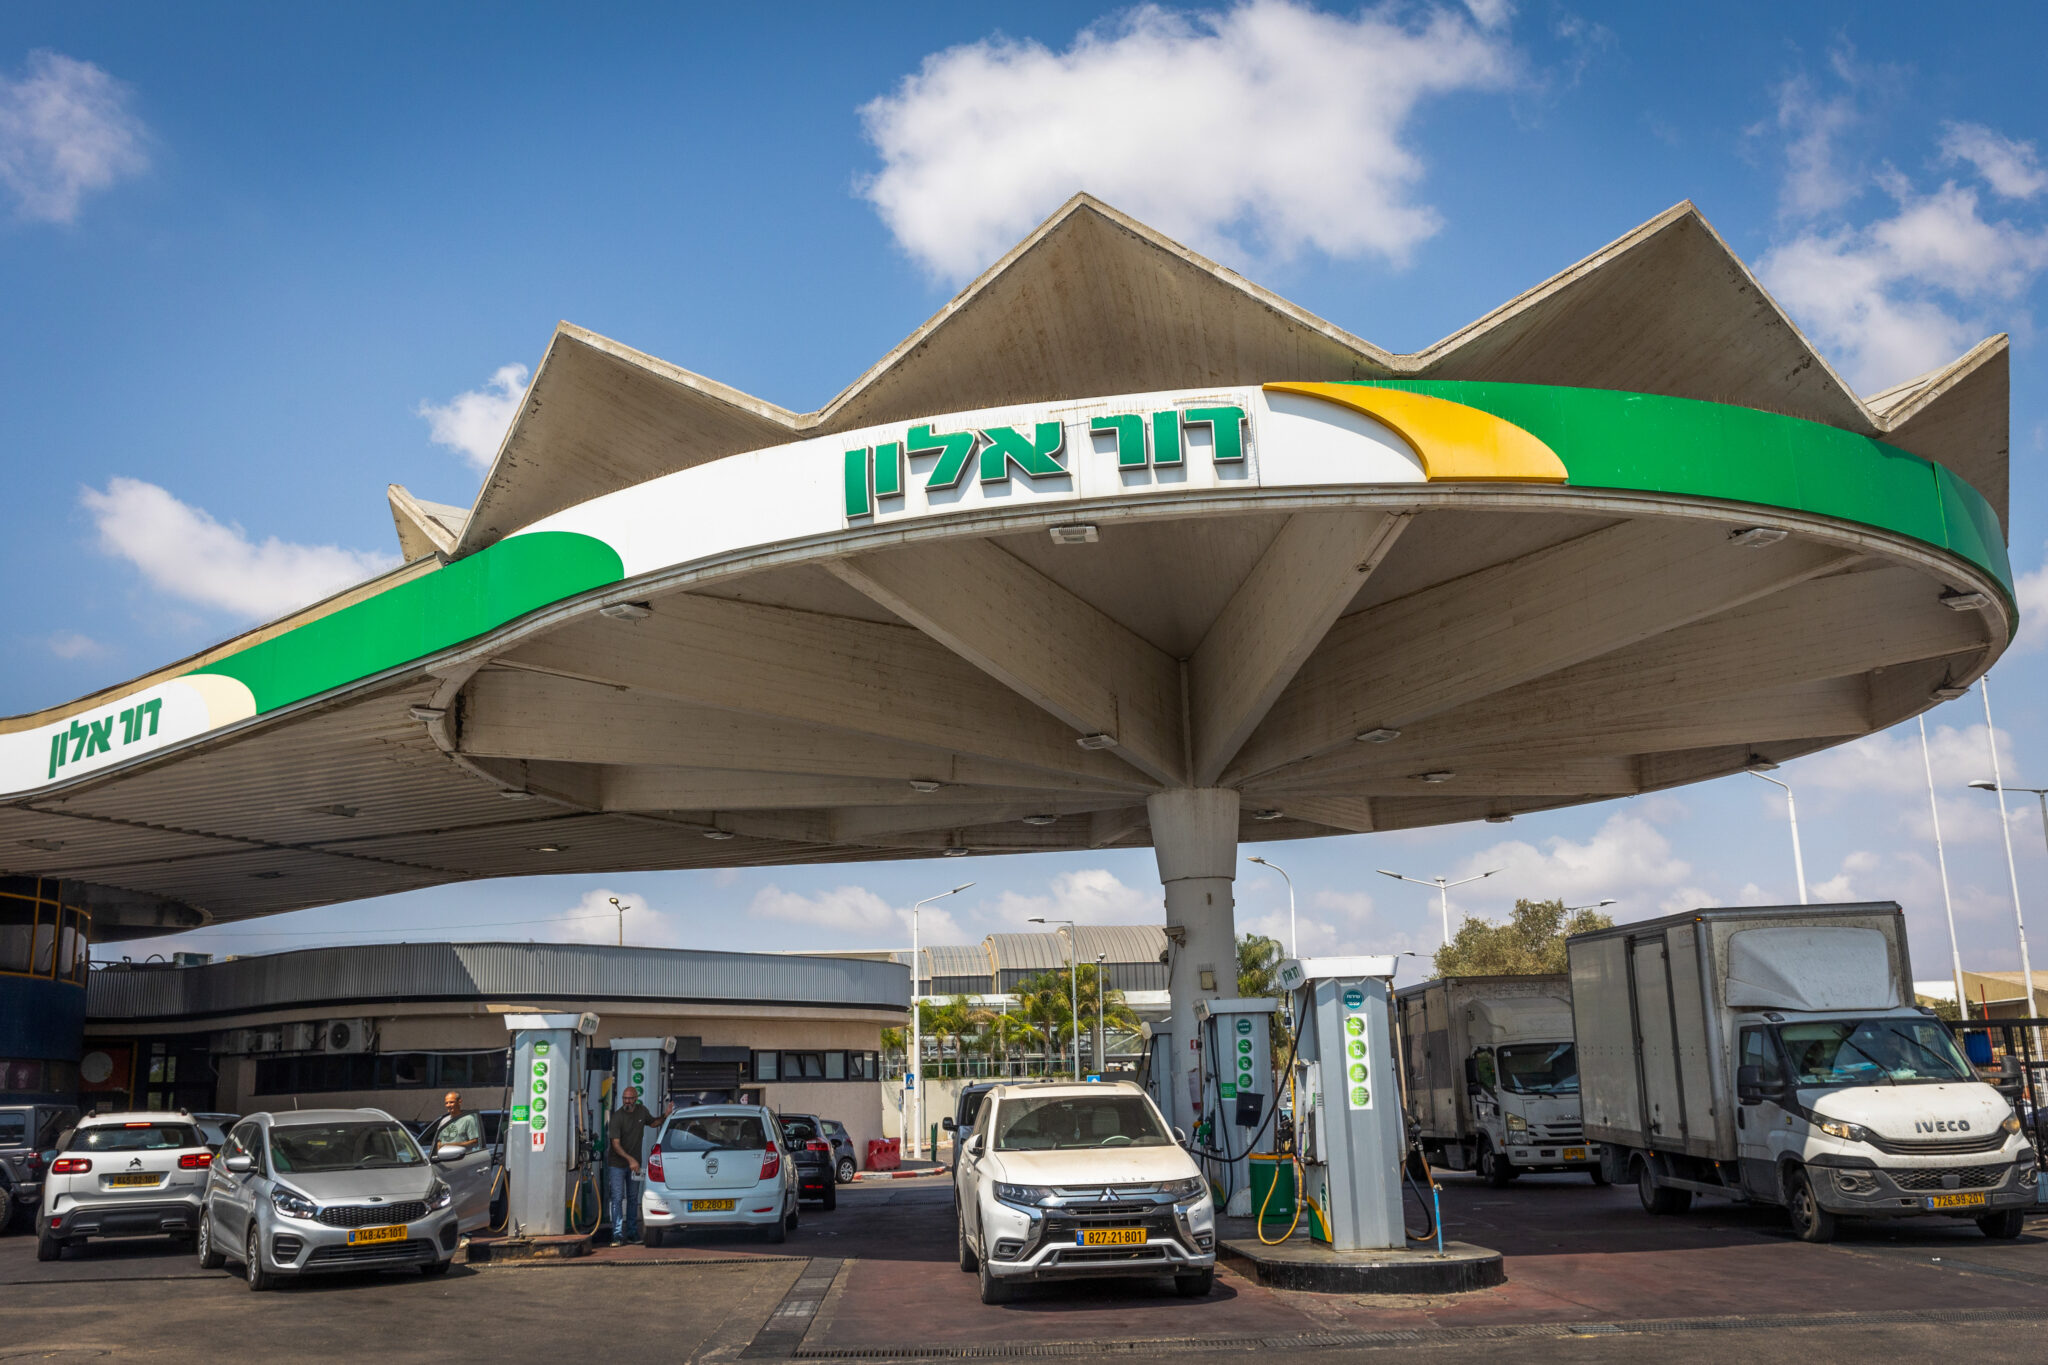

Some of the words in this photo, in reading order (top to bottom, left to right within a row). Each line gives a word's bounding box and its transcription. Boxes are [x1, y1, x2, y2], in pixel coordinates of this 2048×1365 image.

[844, 419, 1071, 519] אלון
[1089, 405, 1247, 471] דור
[48, 715, 114, 780] אלון
[119, 697, 162, 745] דור
[1915, 1120, 1970, 1133] IVECO
